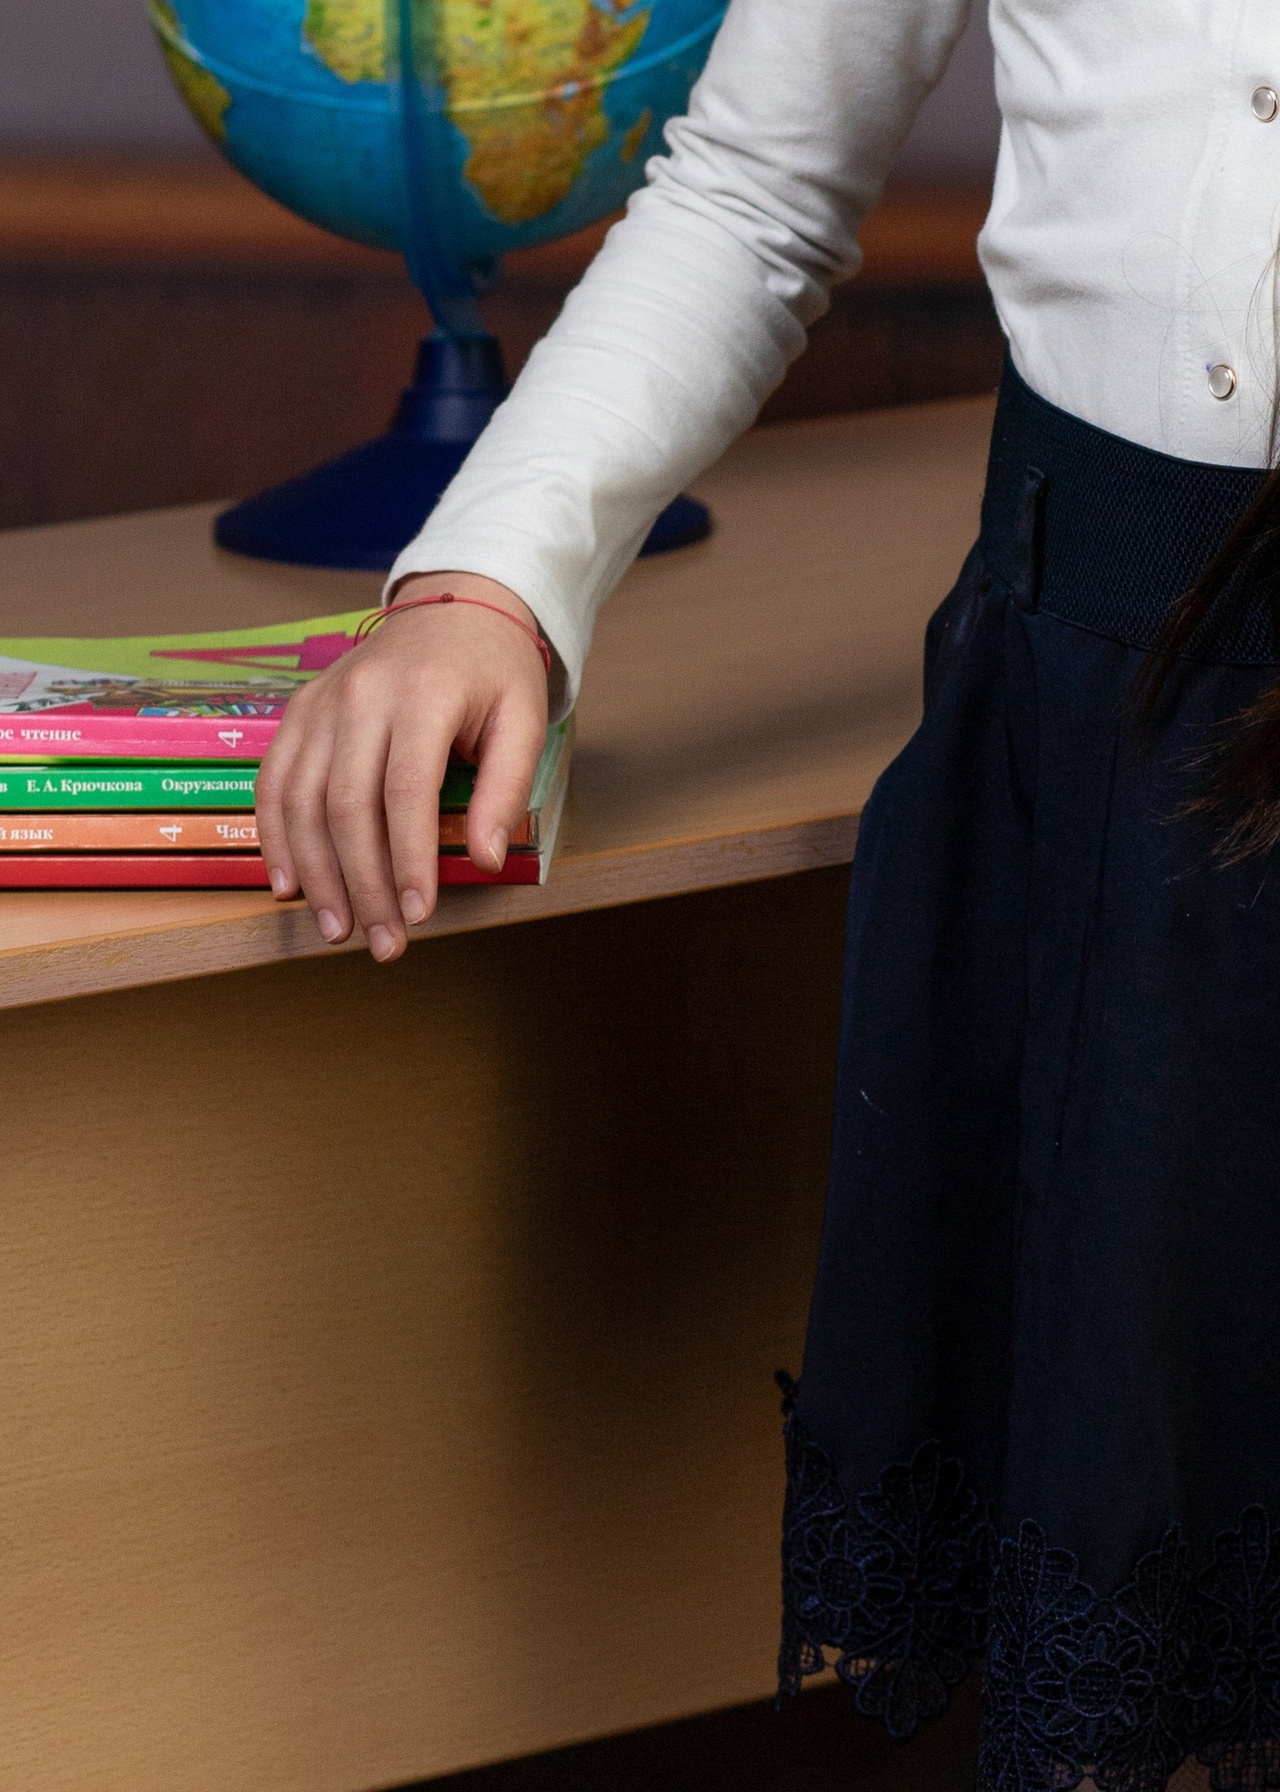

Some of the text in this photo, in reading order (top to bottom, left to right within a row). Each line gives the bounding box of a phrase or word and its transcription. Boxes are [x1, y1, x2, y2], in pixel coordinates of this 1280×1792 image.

[21, 729, 81, 741] чтение
[218, 728, 243, 748] 4
[27, 779, 40, 793] Е.
[43, 779, 58, 793] А.
[61, 779, 143, 796] Крючкова
[162, 778, 255, 795] Окружающ
[10, 828, 53, 840] язык
[159, 824, 182, 843] 4
[216, 824, 258, 839] Част
